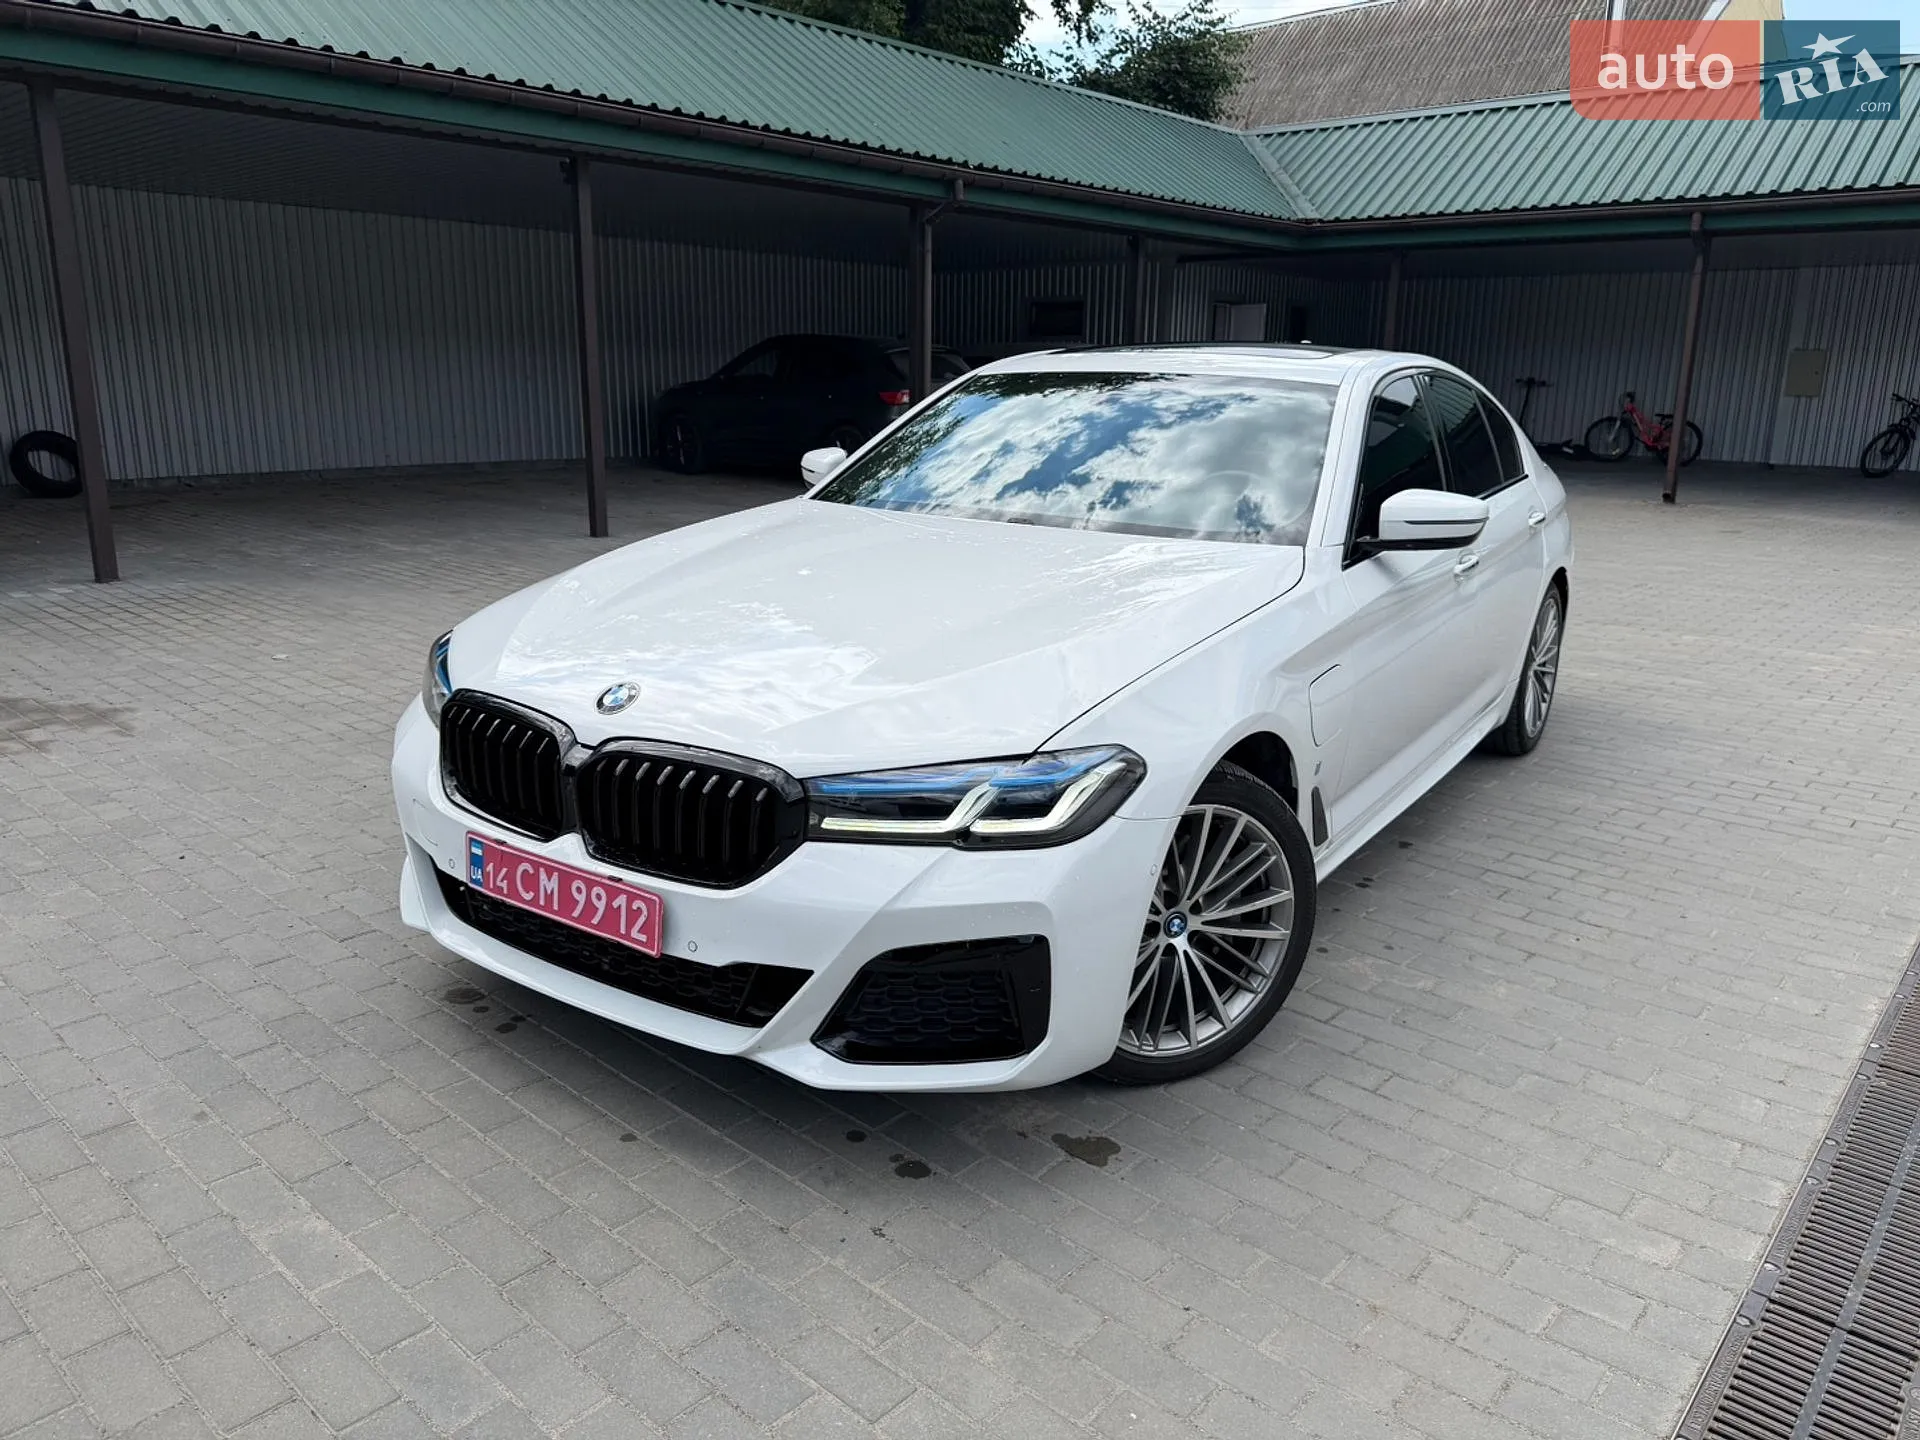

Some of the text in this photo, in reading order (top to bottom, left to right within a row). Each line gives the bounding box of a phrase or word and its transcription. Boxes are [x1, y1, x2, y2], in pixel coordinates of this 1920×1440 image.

[470, 865, 483, 882] UA
[486, 862, 648, 943] 14 CM 9912
